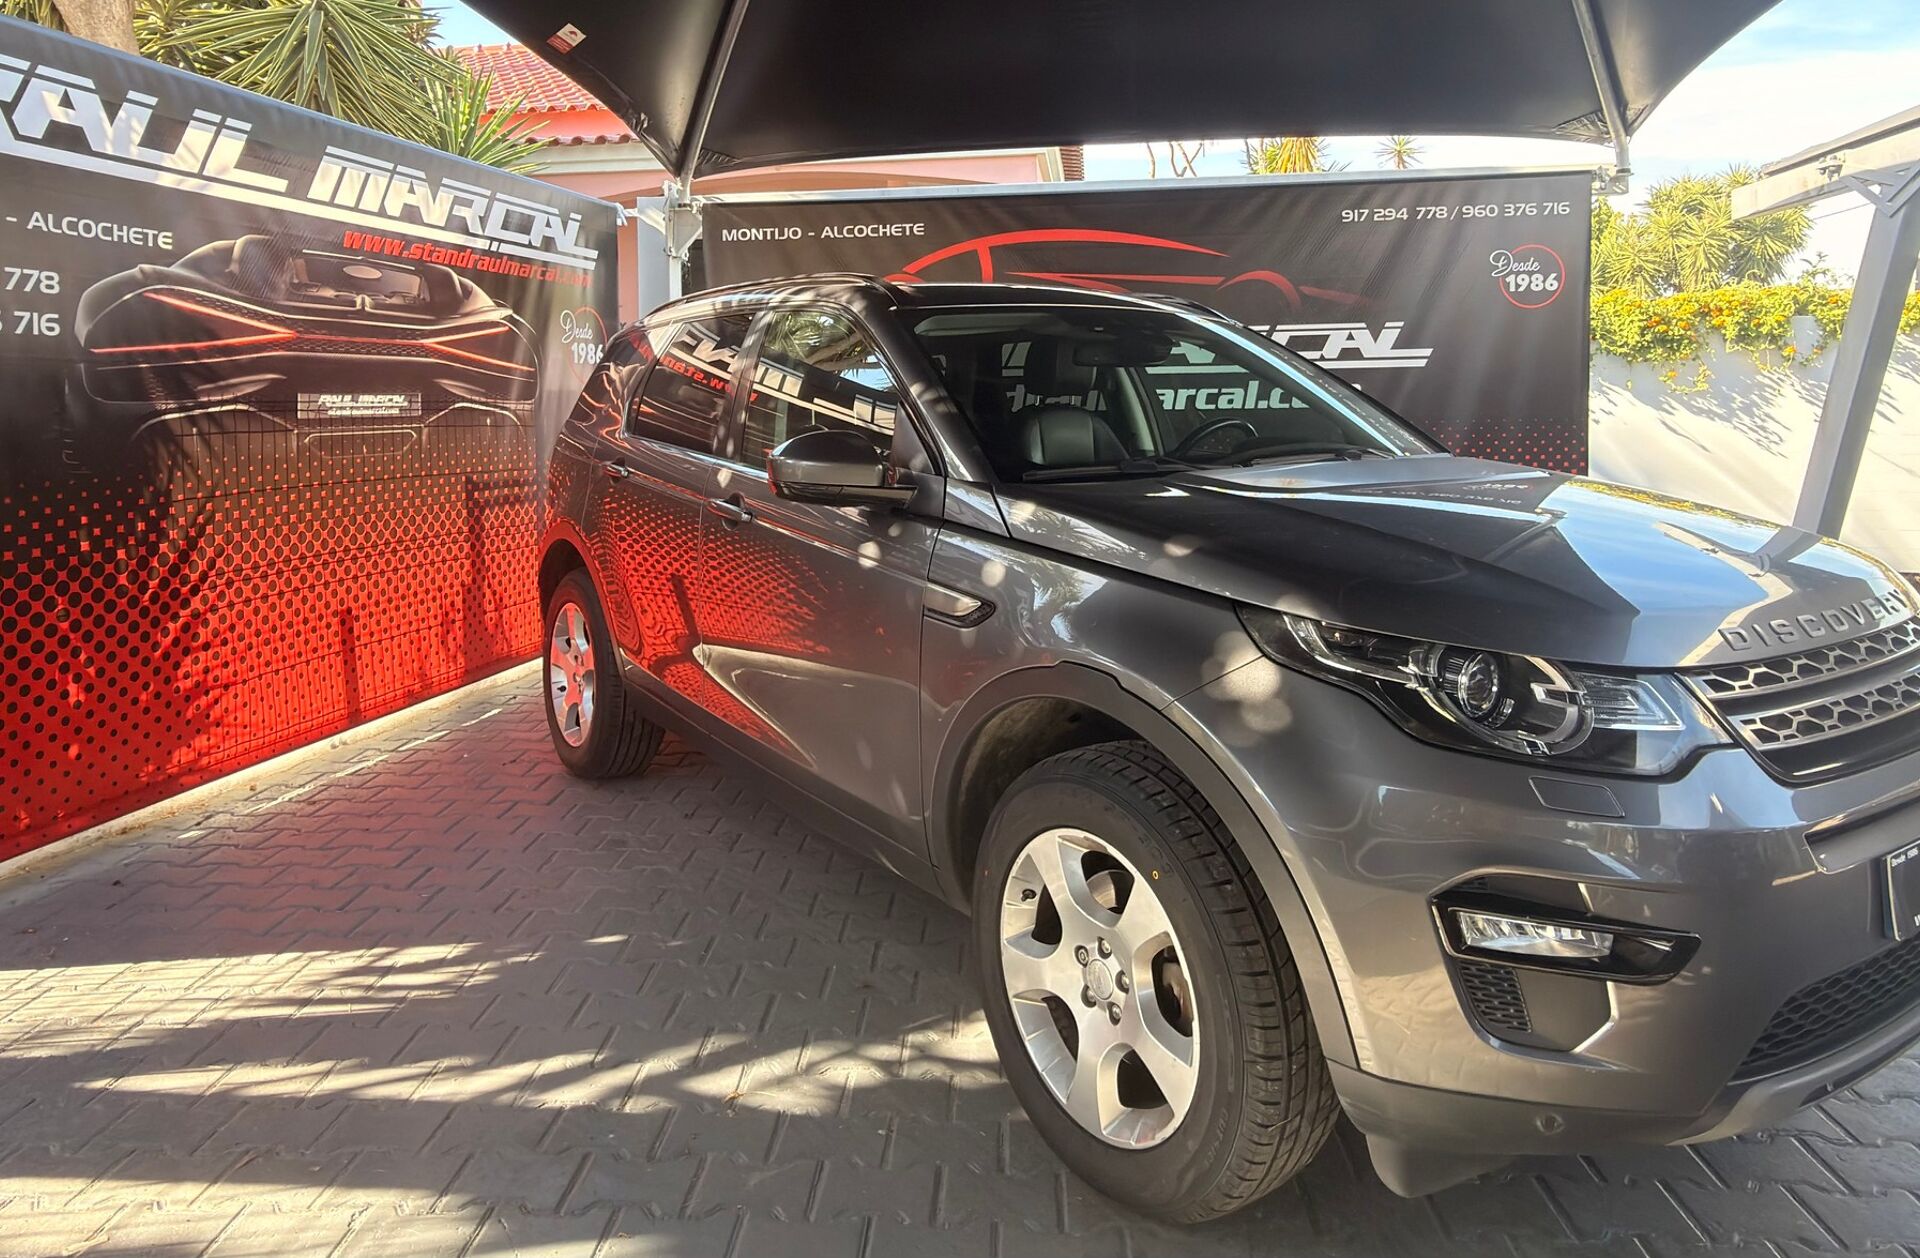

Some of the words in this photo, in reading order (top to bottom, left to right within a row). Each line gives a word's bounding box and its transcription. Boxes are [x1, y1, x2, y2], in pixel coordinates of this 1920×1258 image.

[1341, 208, 1369, 223] 917
[1373, 207, 1408, 222] 294
[1416, 206, 1448, 220] 778
[1462, 204, 1498, 218] 960
[1503, 202, 1538, 217] 376
[1542, 201, 1571, 215] 716
[26, 211, 173, 250] ALCOCHETE
[721, 226, 802, 242] MONTIJO
[820, 223, 925, 239] ALCOCHETE
[343, 230, 592, 288] www.standraulmarcal.com
[1490, 249, 1540, 277] Desde
[4, 266, 61, 294] 778
[1505, 273, 1559, 292] 1986
[13, 310, 61, 336] 716
[560, 309, 593, 343] Desde
[571, 342, 604, 364] 1986
[1717, 588, 1909, 652] DISCOVERY
